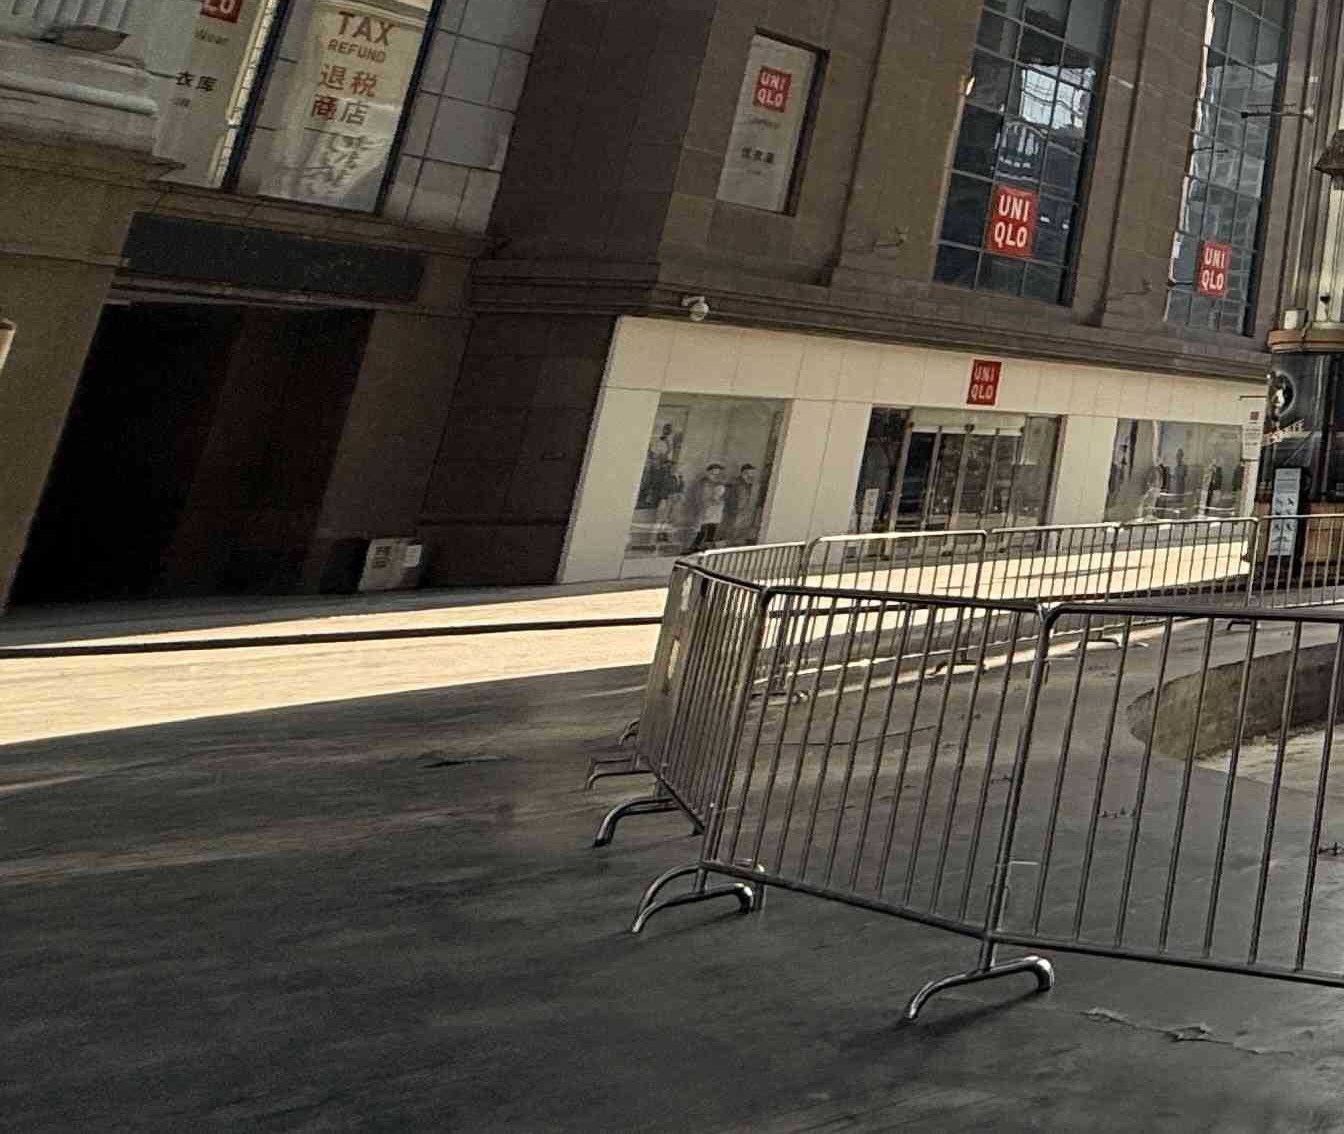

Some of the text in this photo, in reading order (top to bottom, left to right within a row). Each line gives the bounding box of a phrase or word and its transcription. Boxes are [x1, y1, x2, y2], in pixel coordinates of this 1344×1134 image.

[338, 11, 396, 47] TAX
[327, 38, 387, 64] REFUND
[175, 70, 219, 93] 衣库
[319, 64, 379, 98] 退税
[760, 71, 787, 89] UNI
[311, 93, 370, 126] 商店
[757, 88, 784, 108] QLO
[999, 194, 1031, 222] UNI
[994, 221, 1028, 249] QLO
[1203, 247, 1226, 267] UNI
[1200, 269, 1225, 291] QLO
[973, 364, 995, 383] UNI
[970, 383, 995, 401] QLO
